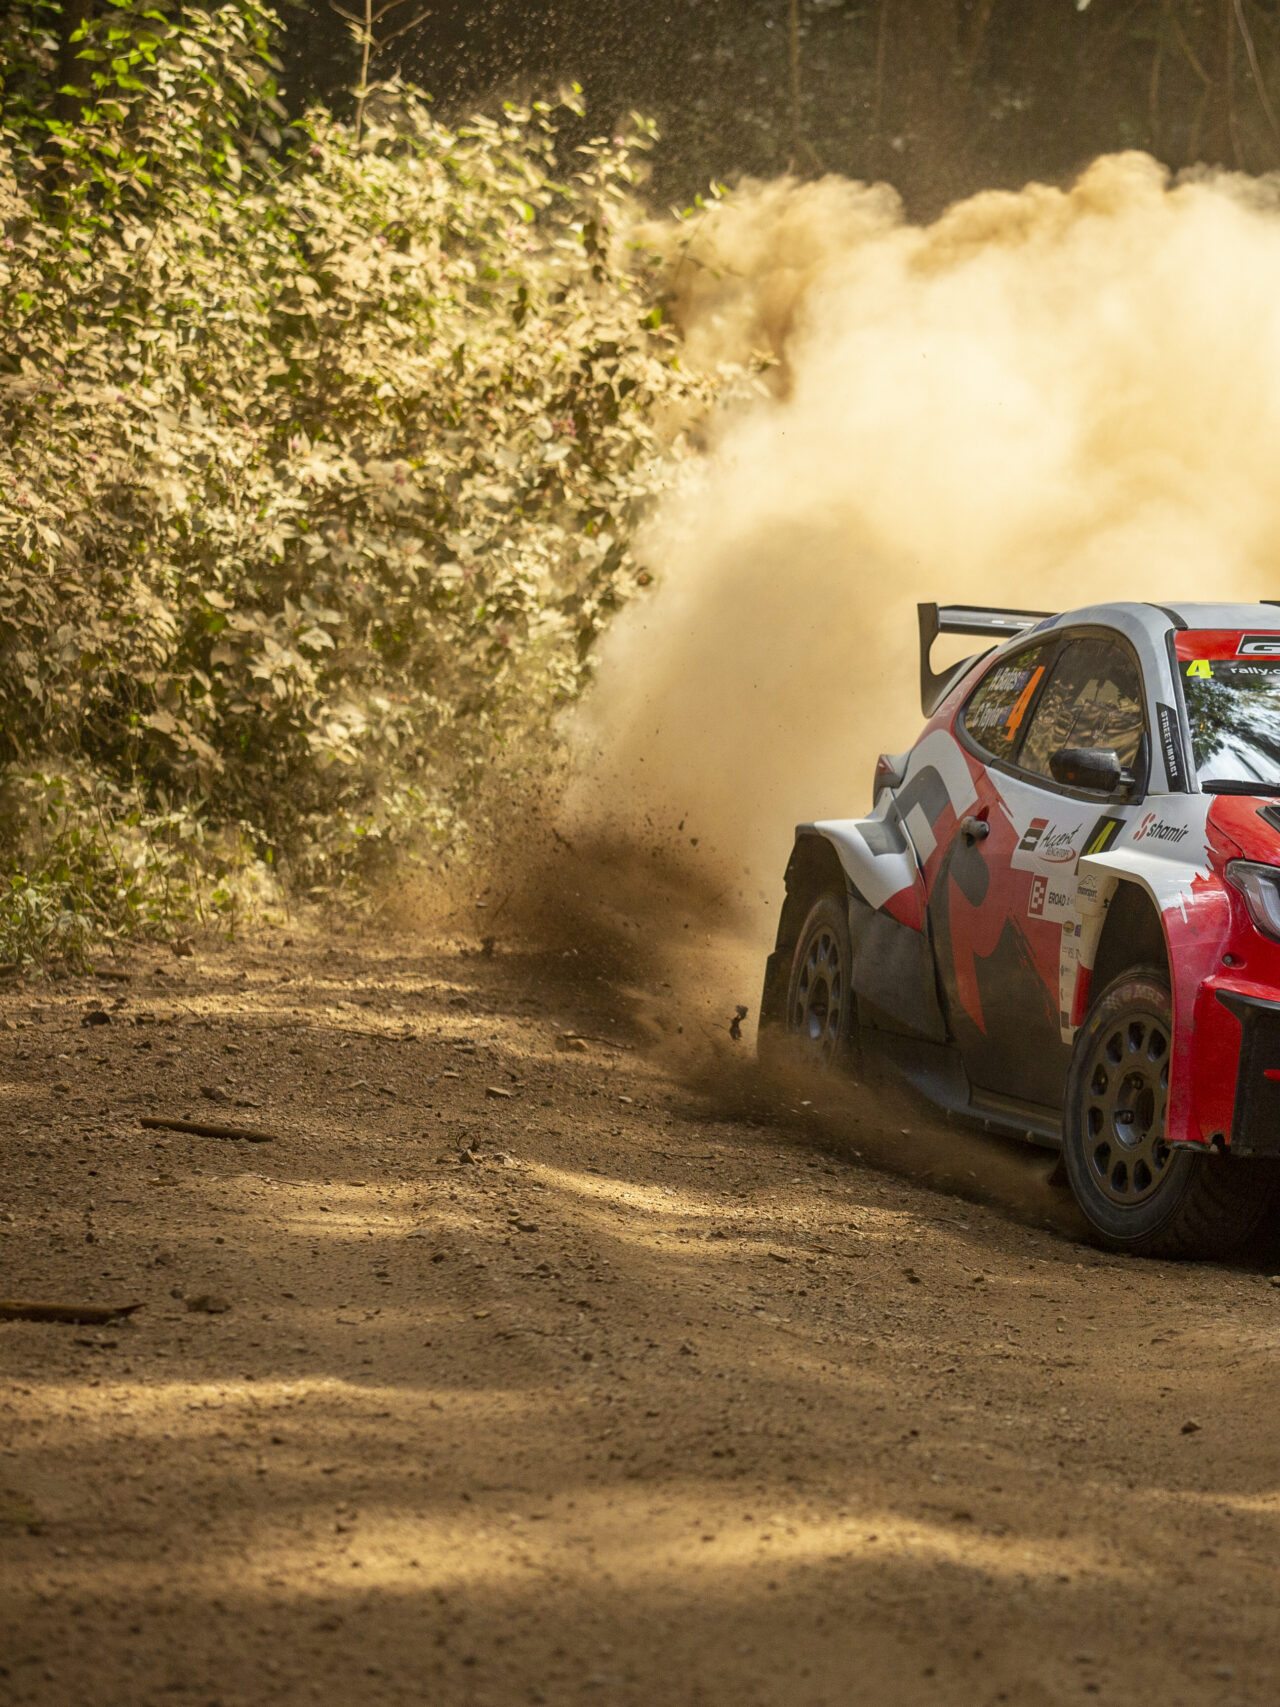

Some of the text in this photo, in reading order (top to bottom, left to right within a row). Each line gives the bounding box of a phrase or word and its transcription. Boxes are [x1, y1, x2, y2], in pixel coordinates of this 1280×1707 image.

[1186, 659, 1215, 679] 4
[1160, 710, 1178, 777] STREET IMPACT
[1039, 823, 1084, 848] Accent
[1147, 820, 1190, 843] shamir
